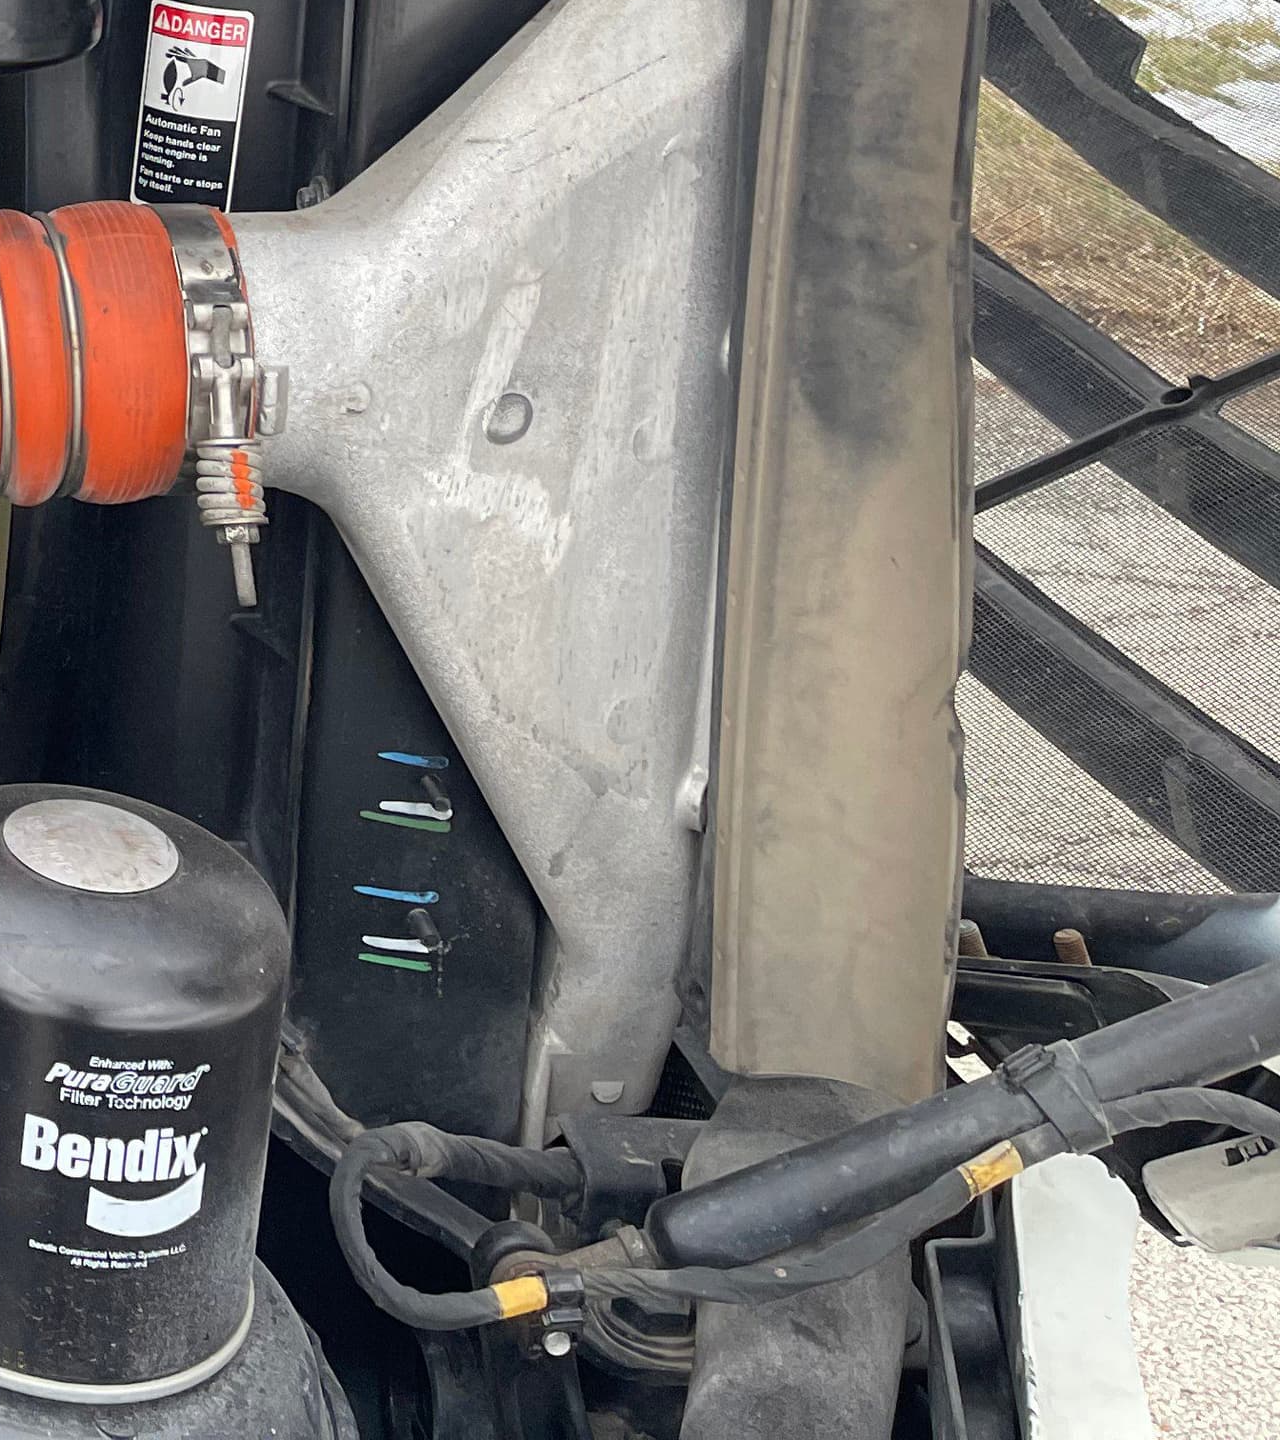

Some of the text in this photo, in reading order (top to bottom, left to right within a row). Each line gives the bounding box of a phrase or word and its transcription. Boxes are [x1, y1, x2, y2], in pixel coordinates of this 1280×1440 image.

[171, 15, 245, 41] DANGER
[145, 113, 221, 137] Automatic Fan
[142, 141, 208, 162] when engine is
[143, 129, 222, 152] Keep hands clear
[141, 152, 175, 168] running.
[138, 175, 174, 194] by itself.
[139, 165, 224, 191] Fan starts or stops
[89, 1056, 146, 1071] Enhanced
[44, 1062, 207, 1095] PuraGuard
[59, 1087, 193, 1111] Filter Technology
[20, 1112, 202, 1183] Bendix
[28, 1239, 58, 1253] Bendix
[58, 1245, 107, 1259] Commercial
[138, 1248, 170, 1261] Systems
[70, 1257, 82, 1266] All
[83, 1258, 109, 1269] Rights
